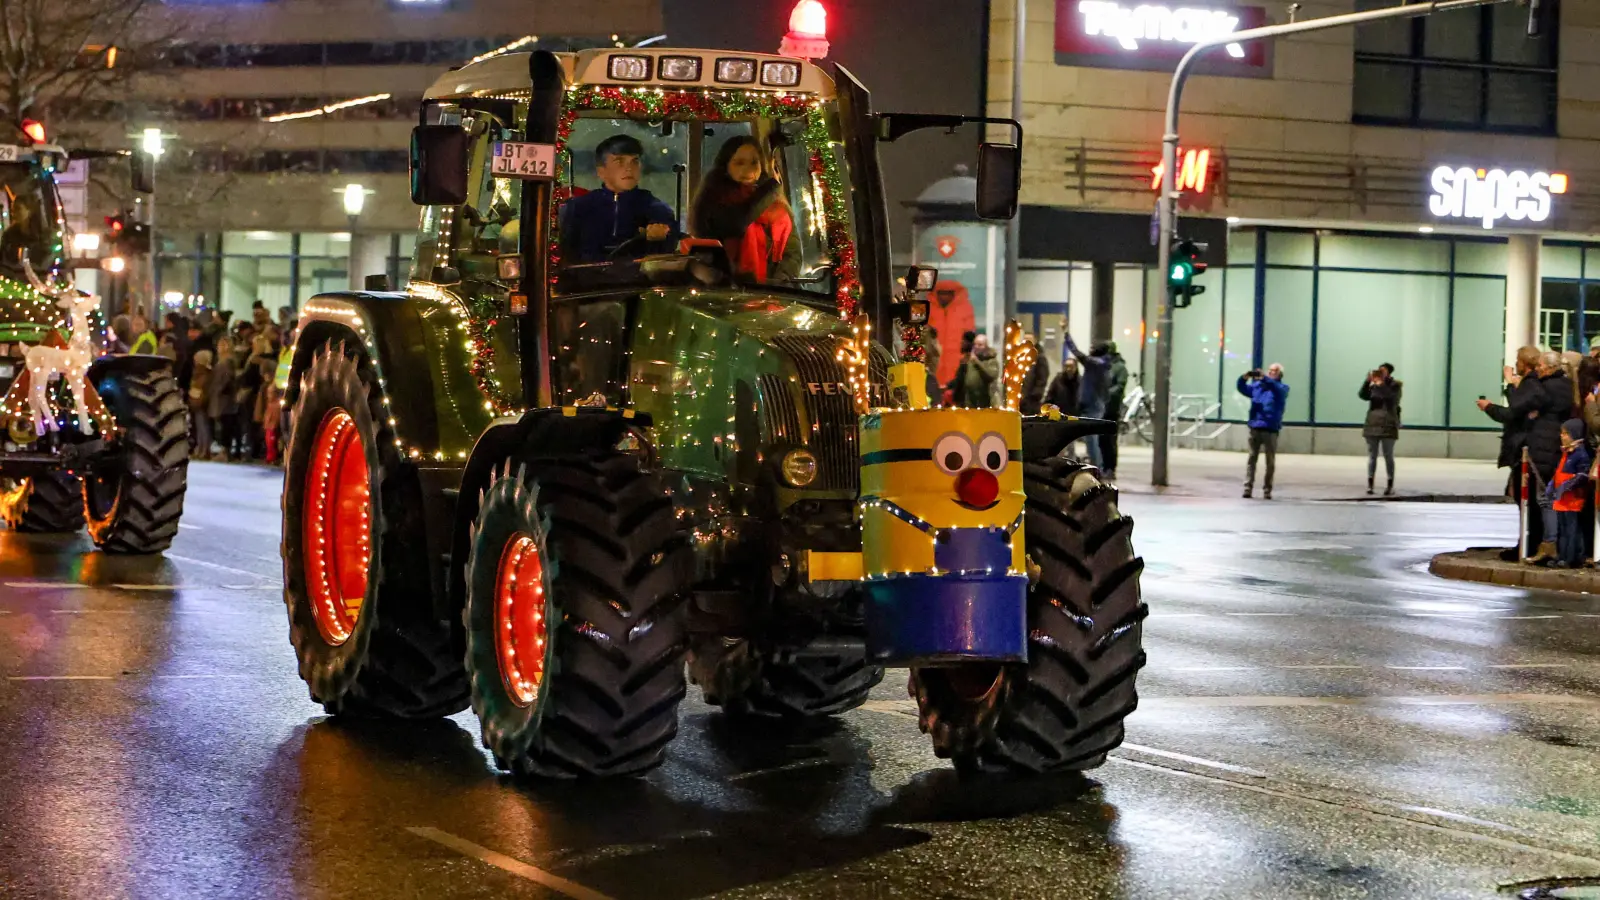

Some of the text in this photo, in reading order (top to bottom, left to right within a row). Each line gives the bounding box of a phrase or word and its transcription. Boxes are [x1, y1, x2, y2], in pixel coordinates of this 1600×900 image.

[504, 143, 524, 159] BT
[498, 158, 548, 175] JL 412
[807, 382, 884, 396] FENT
